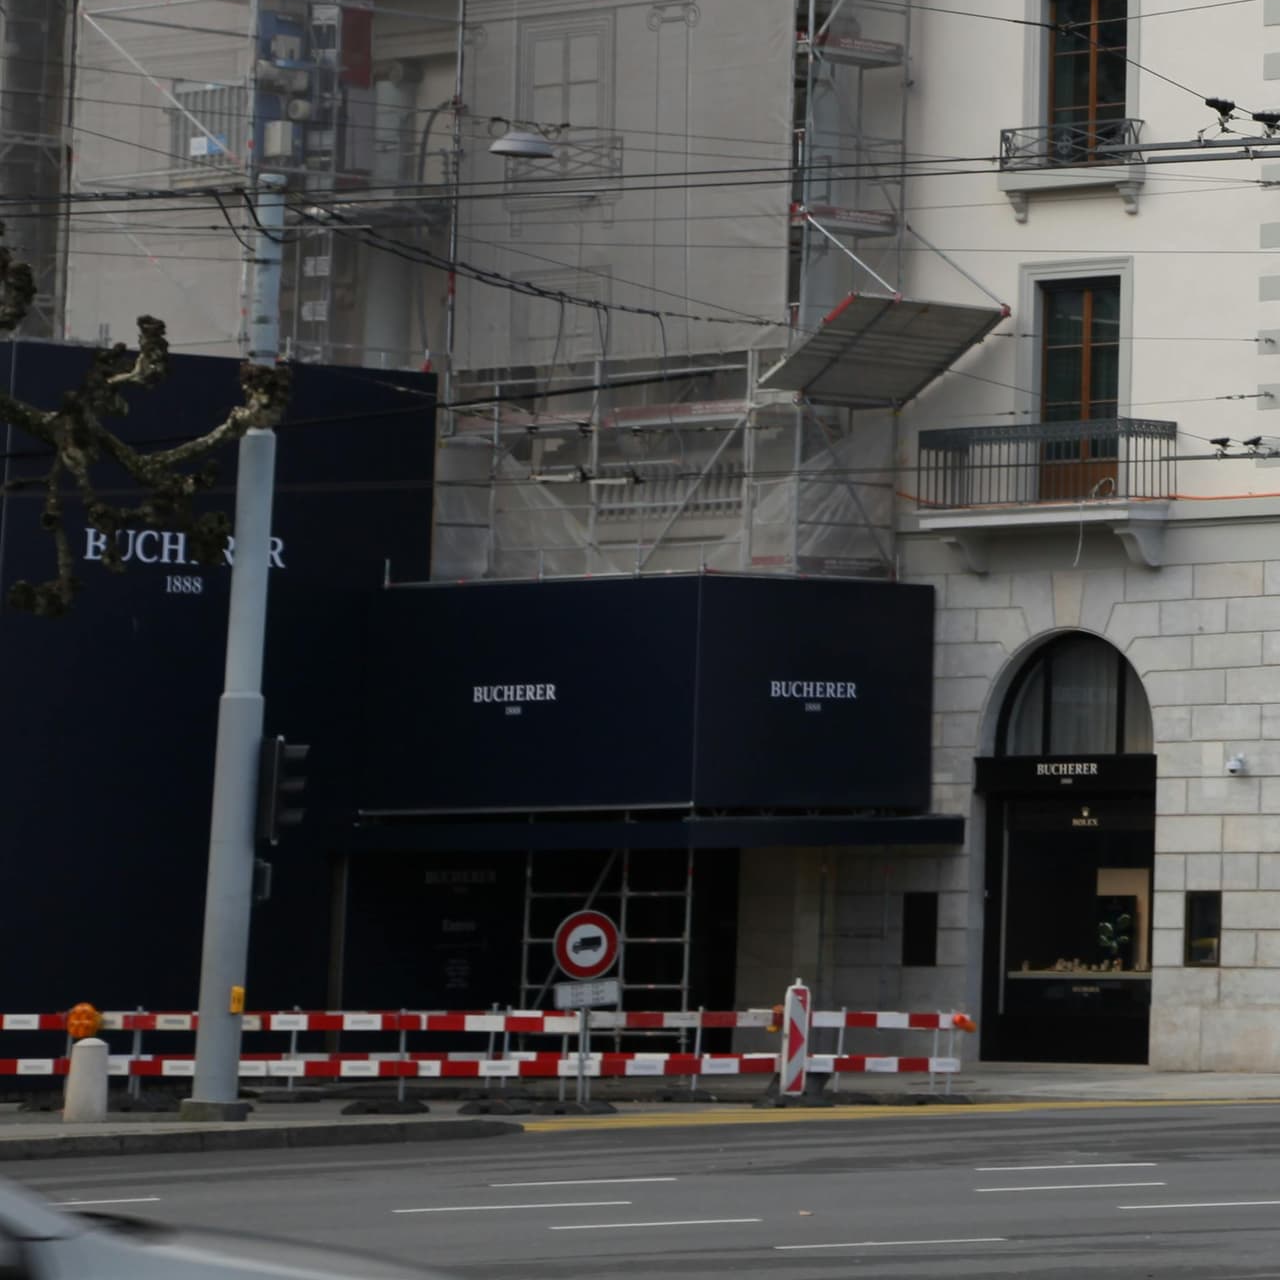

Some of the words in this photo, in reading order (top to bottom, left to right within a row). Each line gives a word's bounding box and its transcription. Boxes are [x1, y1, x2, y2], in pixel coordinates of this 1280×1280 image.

[165, 575, 203, 594] 1888
[472, 683, 558, 703] BUCHERER
[770, 680, 858, 699] BUCHERER
[1036, 763, 1099, 776] BUCHERER
